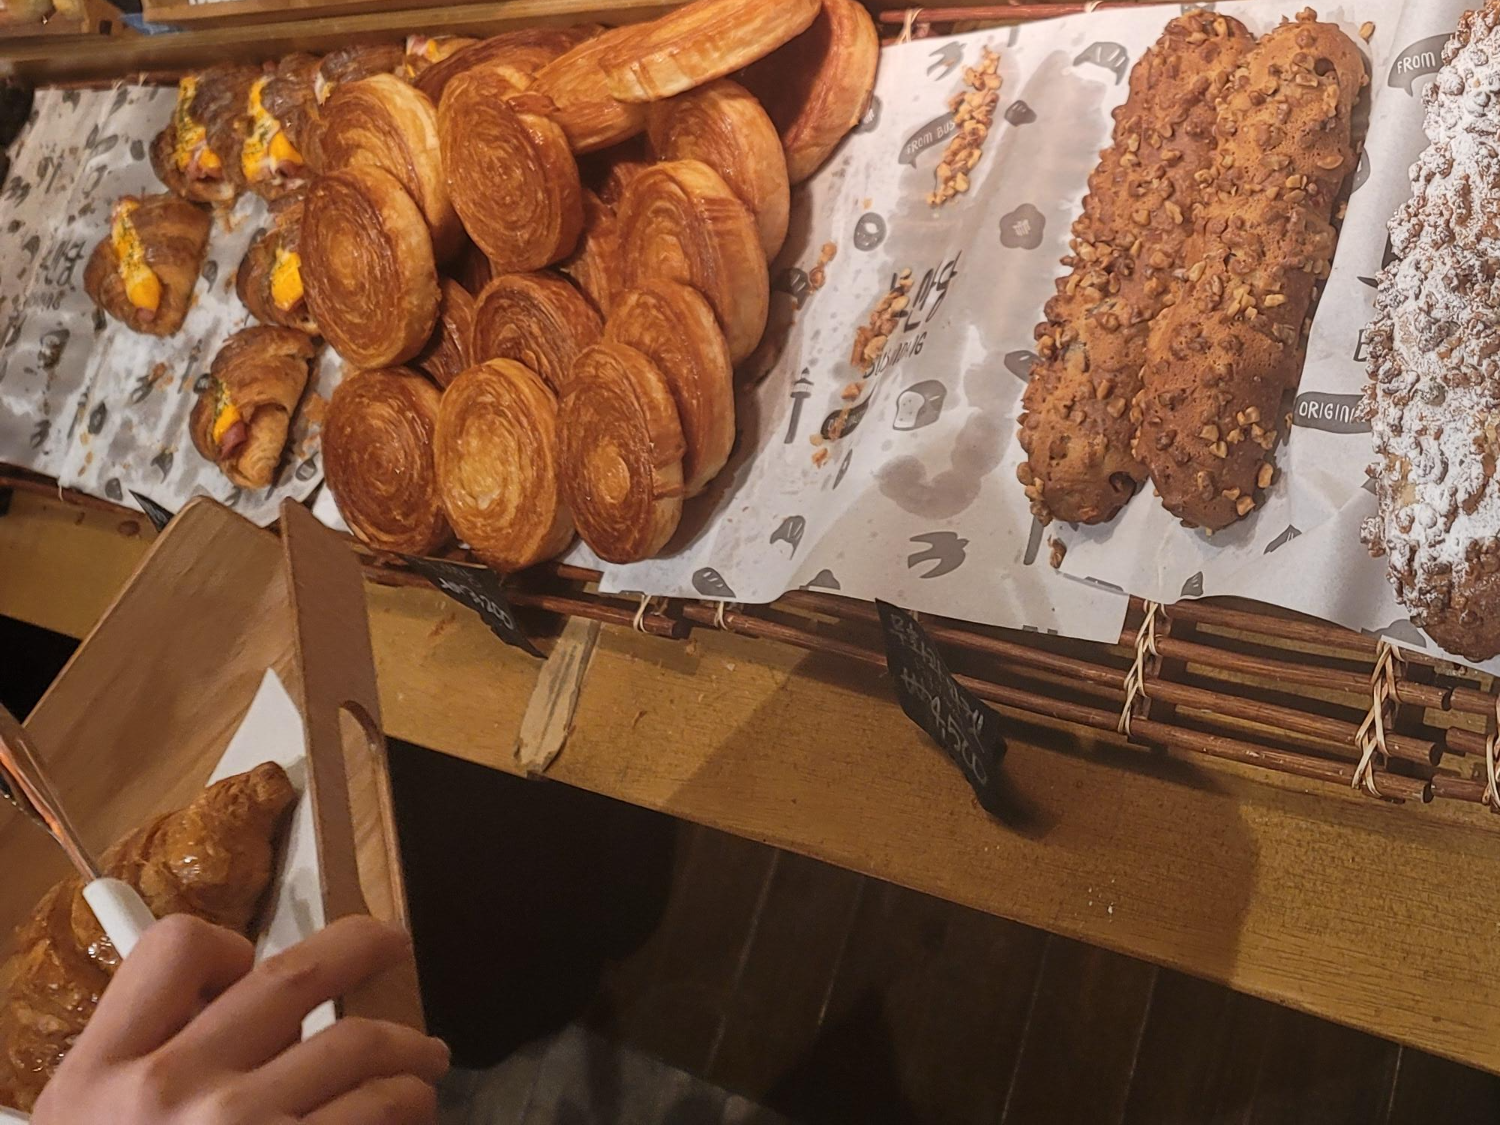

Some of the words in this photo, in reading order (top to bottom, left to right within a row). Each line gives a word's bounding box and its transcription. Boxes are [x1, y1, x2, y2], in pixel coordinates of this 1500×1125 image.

[1397, 51, 1436, 74] FROM
[906, 131, 933, 154] FROM
[936, 119, 956, 139] BUS
[1299, 401, 1356, 424] ORIGIN
